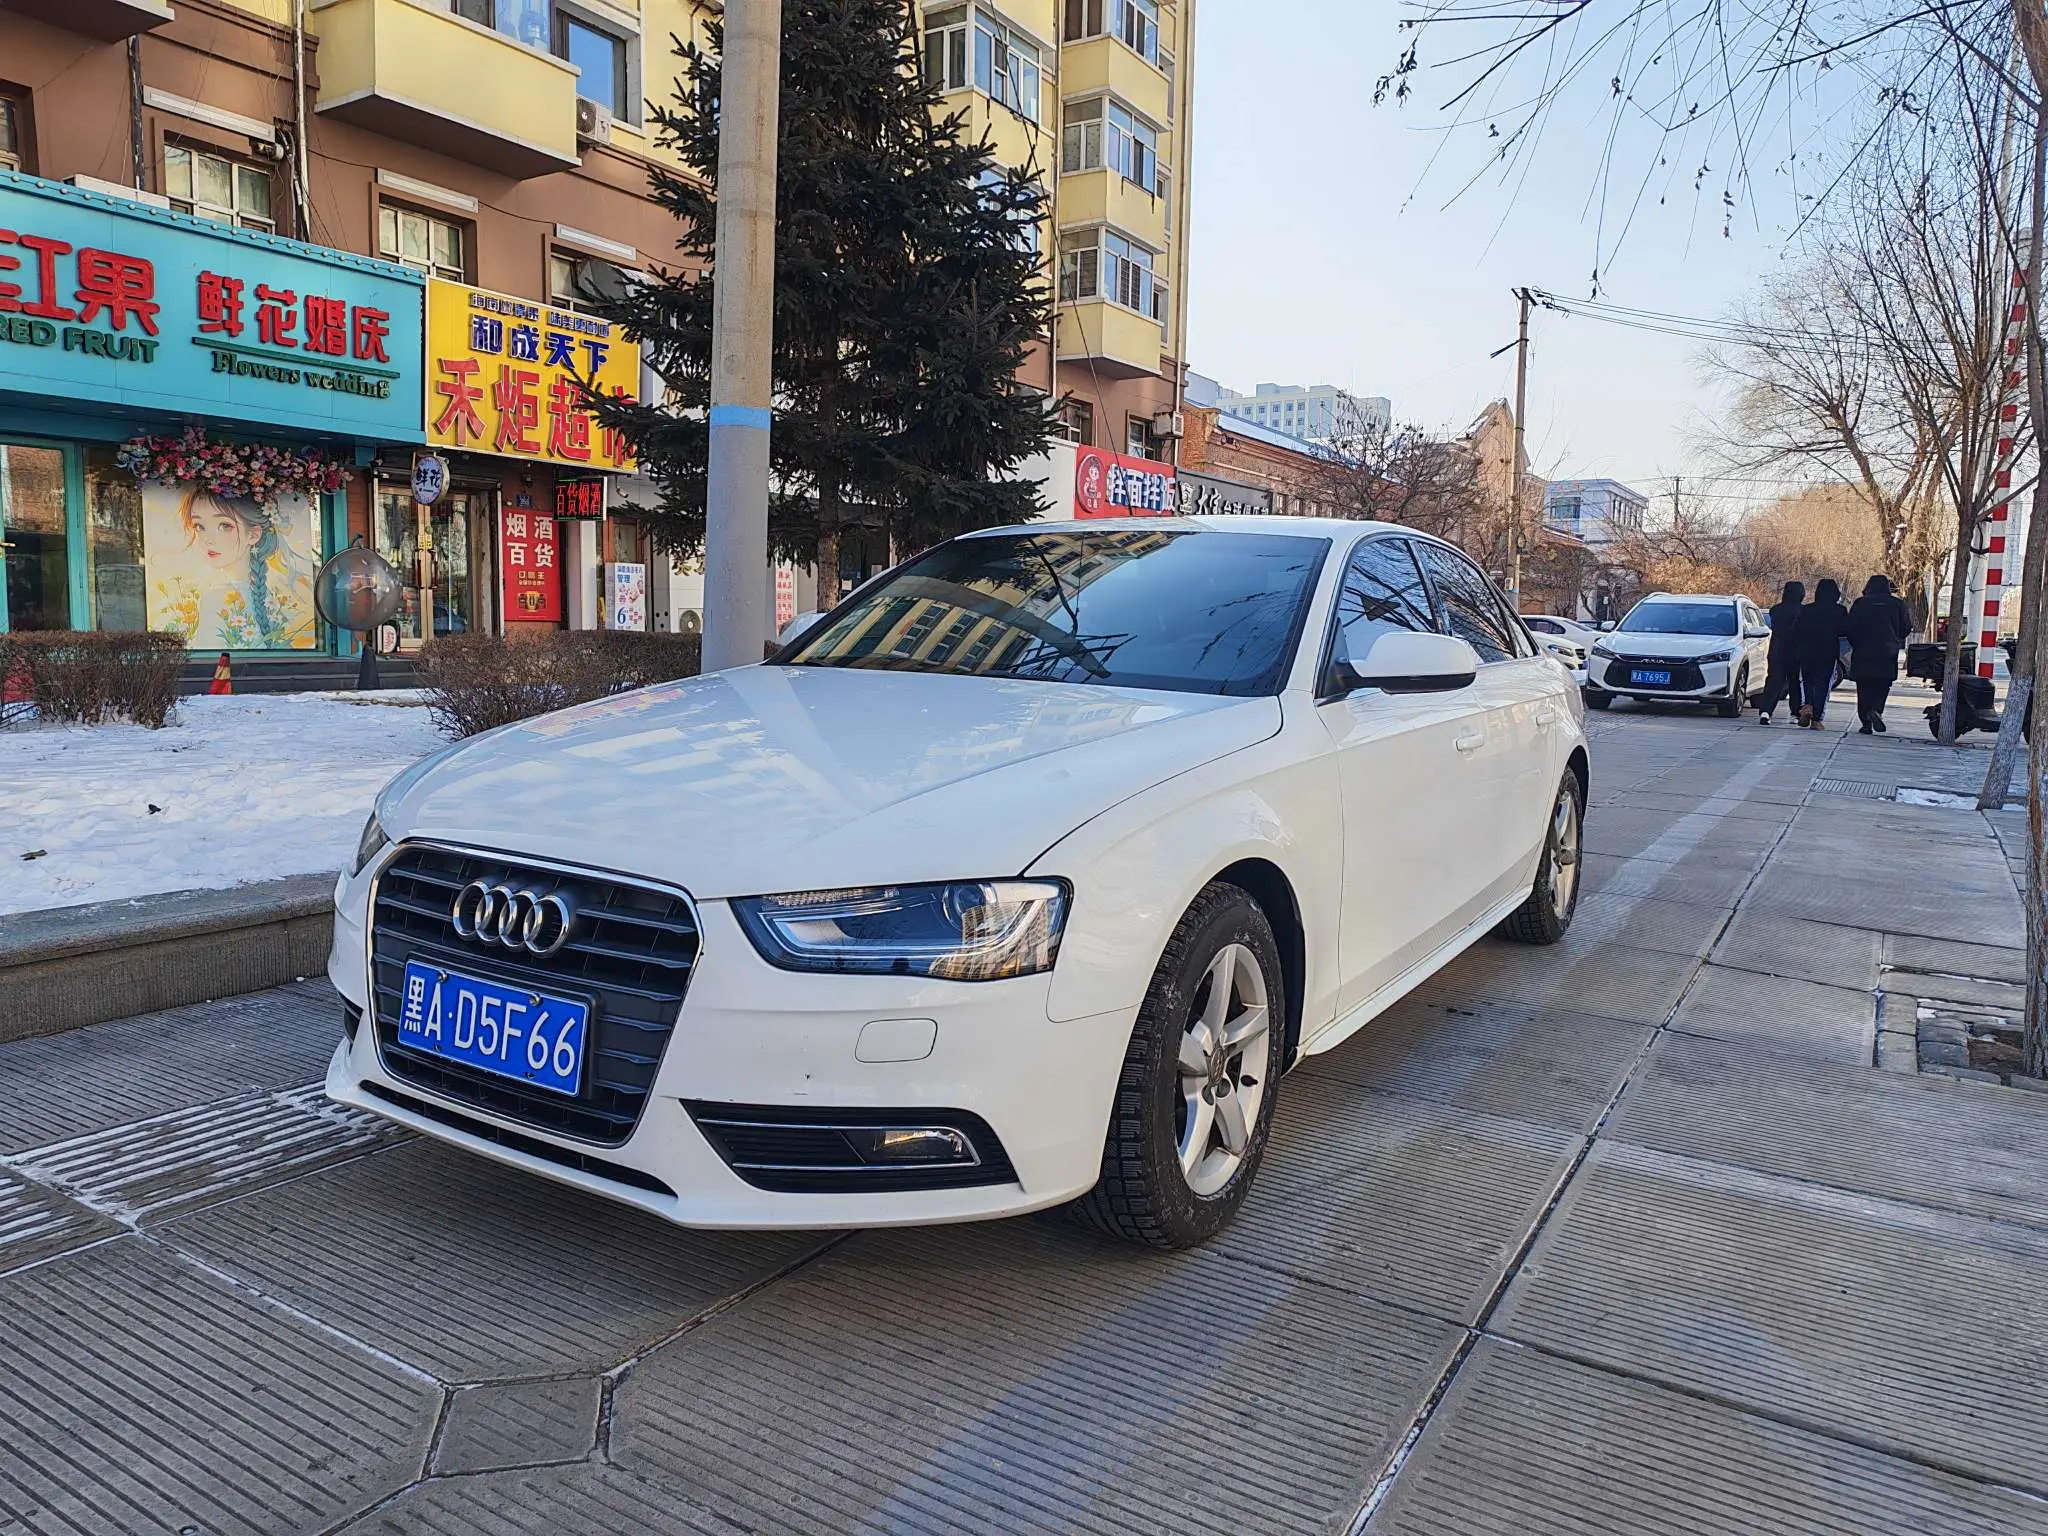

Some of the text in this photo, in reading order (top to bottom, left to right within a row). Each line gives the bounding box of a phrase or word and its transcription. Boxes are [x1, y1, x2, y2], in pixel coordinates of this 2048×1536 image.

[198, 270, 391, 363] 鲜花婚庆
[64, 327, 160, 363] FRUIT
[470, 314, 610, 374] 和成天下
[211, 350, 391, 398] Flowers wedding
[416, 467, 441, 488] 鲜花
[1106, 463, 1176, 514] 拌面拌饭
[555, 482, 601, 516] 百货烟酒
[506, 513, 554, 540] 烟酒
[506, 542, 554, 568] 百货
